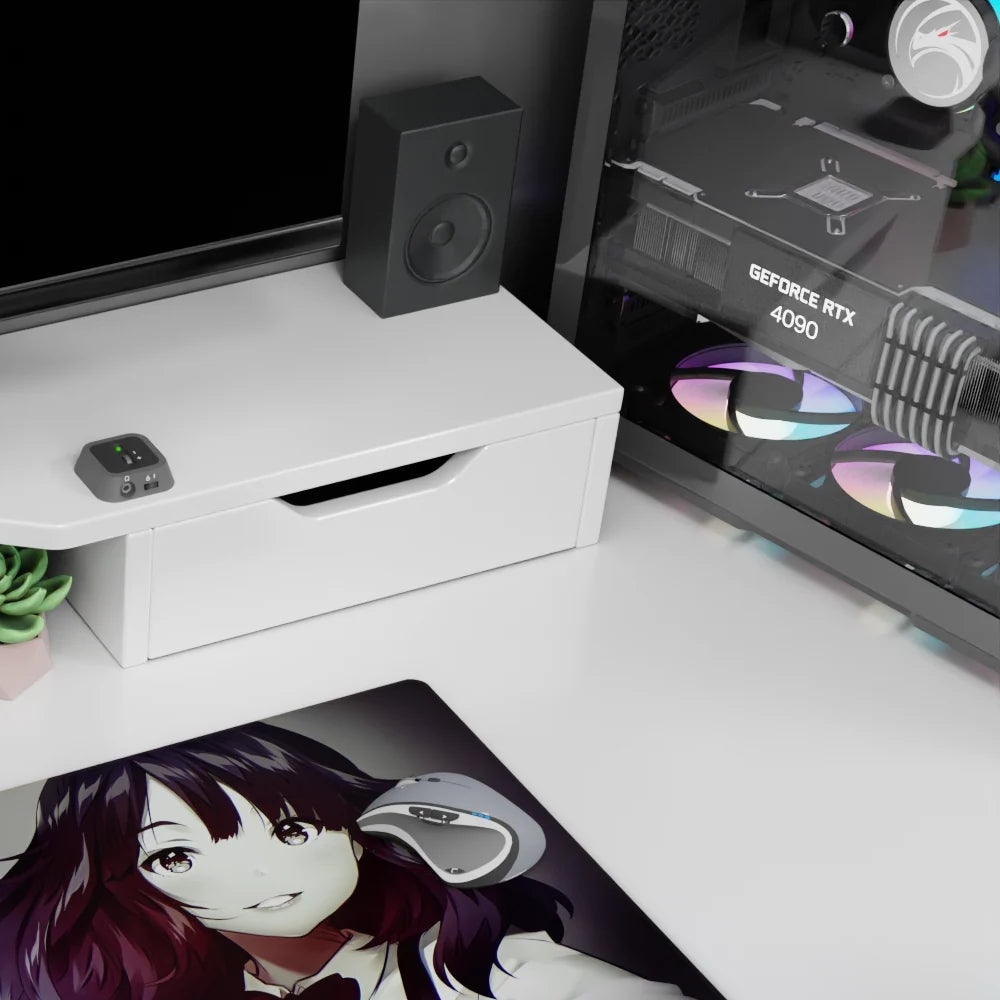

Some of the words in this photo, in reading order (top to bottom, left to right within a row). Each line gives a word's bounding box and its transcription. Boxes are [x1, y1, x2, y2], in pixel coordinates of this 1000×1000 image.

[749, 263, 820, 309] GEFORCE
[822, 298, 857, 326] RTX
[769, 305, 819, 340] 4090
